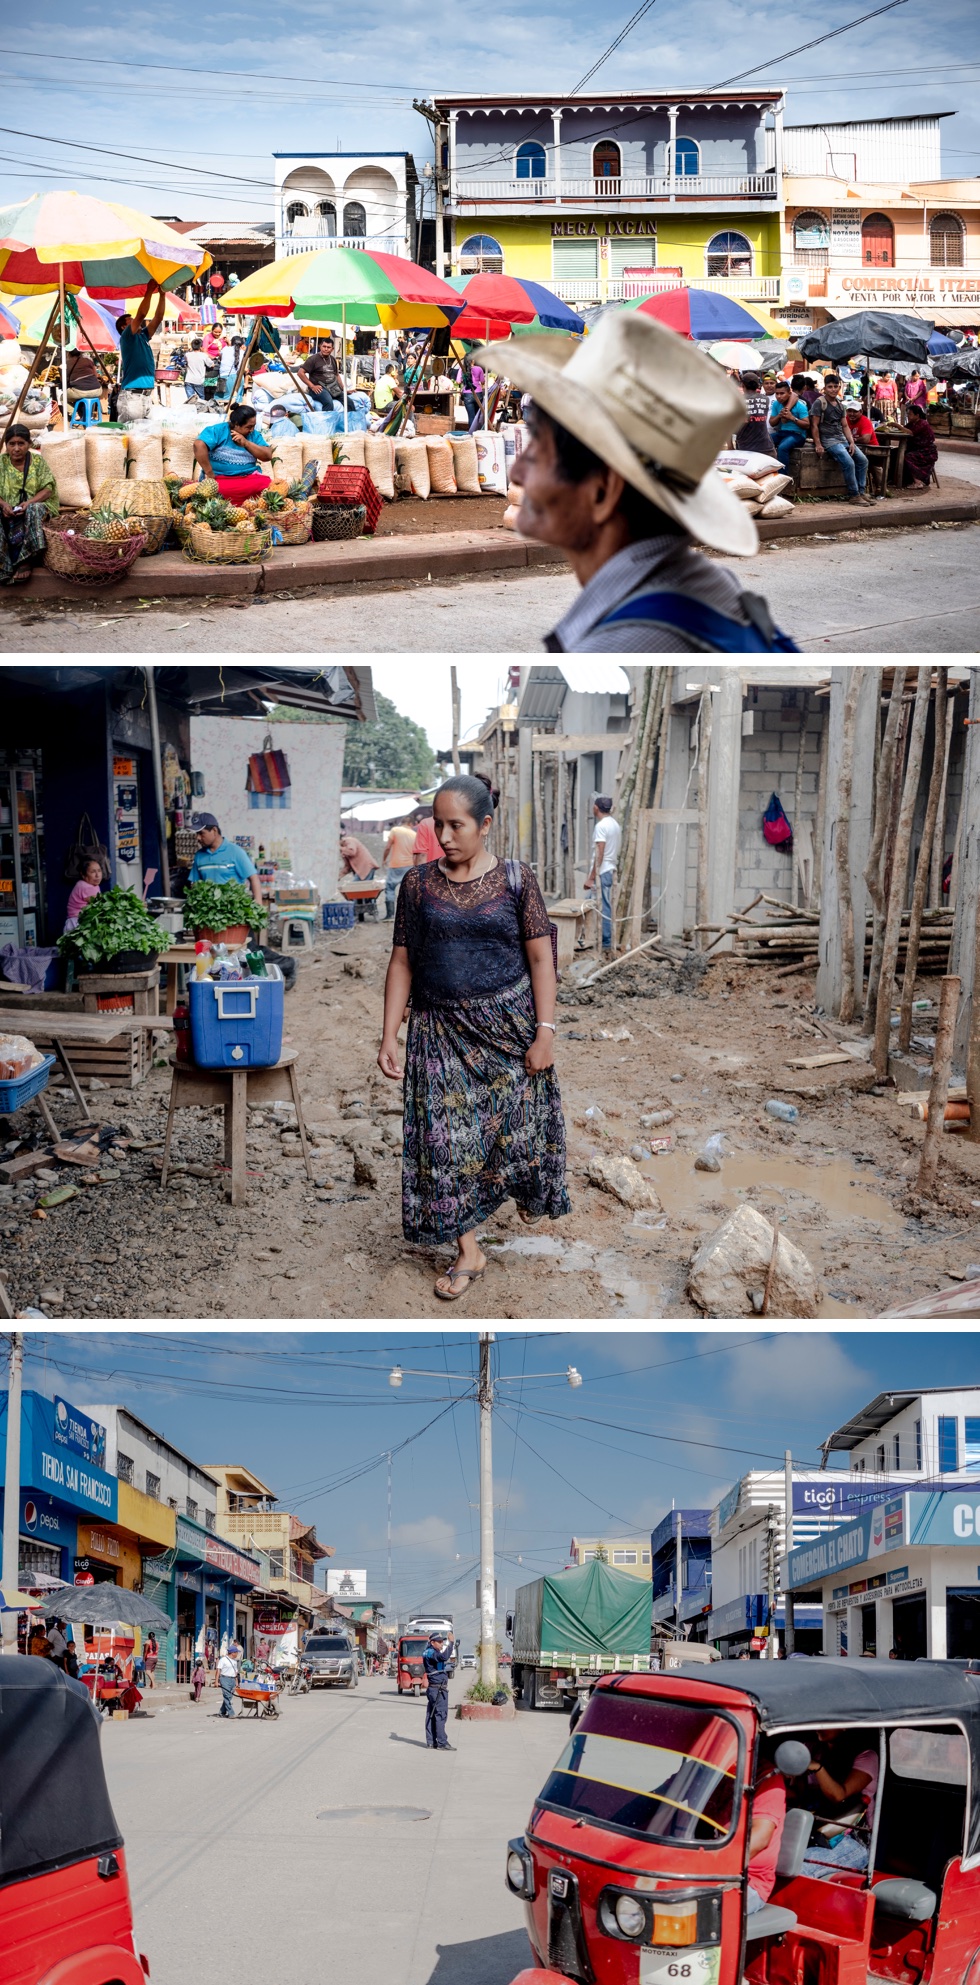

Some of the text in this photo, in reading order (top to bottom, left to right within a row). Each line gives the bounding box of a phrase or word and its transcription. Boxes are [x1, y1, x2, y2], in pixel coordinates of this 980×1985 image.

[551, 220, 657, 236] MEGA IXCAN
[842, 277, 934, 292] COMERCIAL
[849, 293, 877, 303] VENTA
[883, 293, 901, 303] POR
[941, 293, 947, 303] Y
[70, 1419, 87, 1440] TIENDA
[55, 1431, 68, 1445] pepsi
[42, 1452, 112, 1508] TIENDA SAN FRANCISCO
[804, 1487, 891, 1511] tigo express
[40, 1513, 61, 1531] pepsi
[953, 1504, 980, 1538] C
[792, 1527, 864, 1582] COMERCIAL EL CHATO
[75, 1559, 90, 1570] tigo
[828, 1602, 836, 1611] VENTA
[837, 1600, 842, 1608] DE
[842, 1595, 859, 1607] REPUESTOS
[864, 1589, 883, 1602] ACCESORIOS
[884, 1586, 893, 1597] PARA
[895, 1578, 923, 1594] MOTOCICLETAS
[282, 1611, 299, 1620] ABC
[642, 1948, 678, 1957] MOTOTAXI
[668, 1963, 692, 1978] 68
